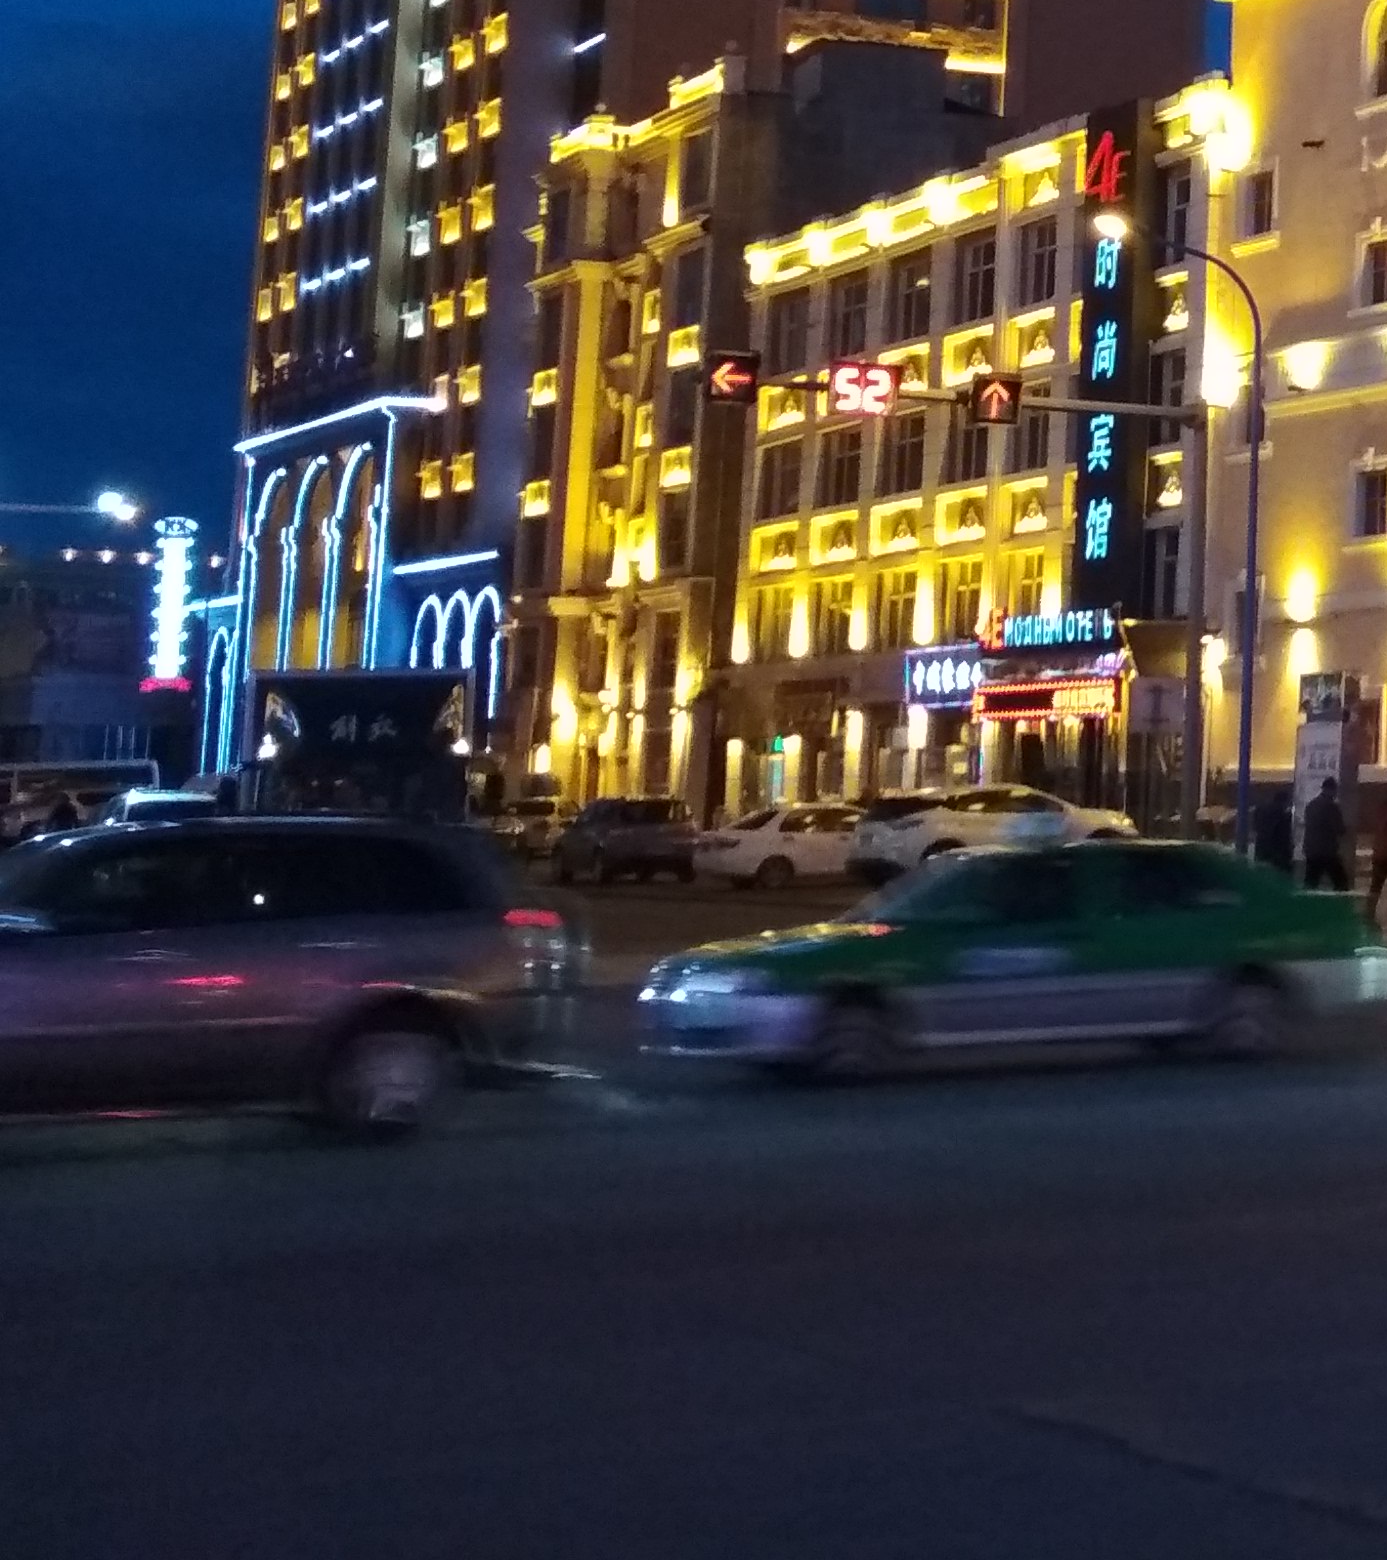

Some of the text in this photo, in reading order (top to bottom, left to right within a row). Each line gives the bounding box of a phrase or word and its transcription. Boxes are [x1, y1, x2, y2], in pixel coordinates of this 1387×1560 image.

[834, 367, 891, 414] 52
[1084, 237, 1122, 561] 时尚宾馆
